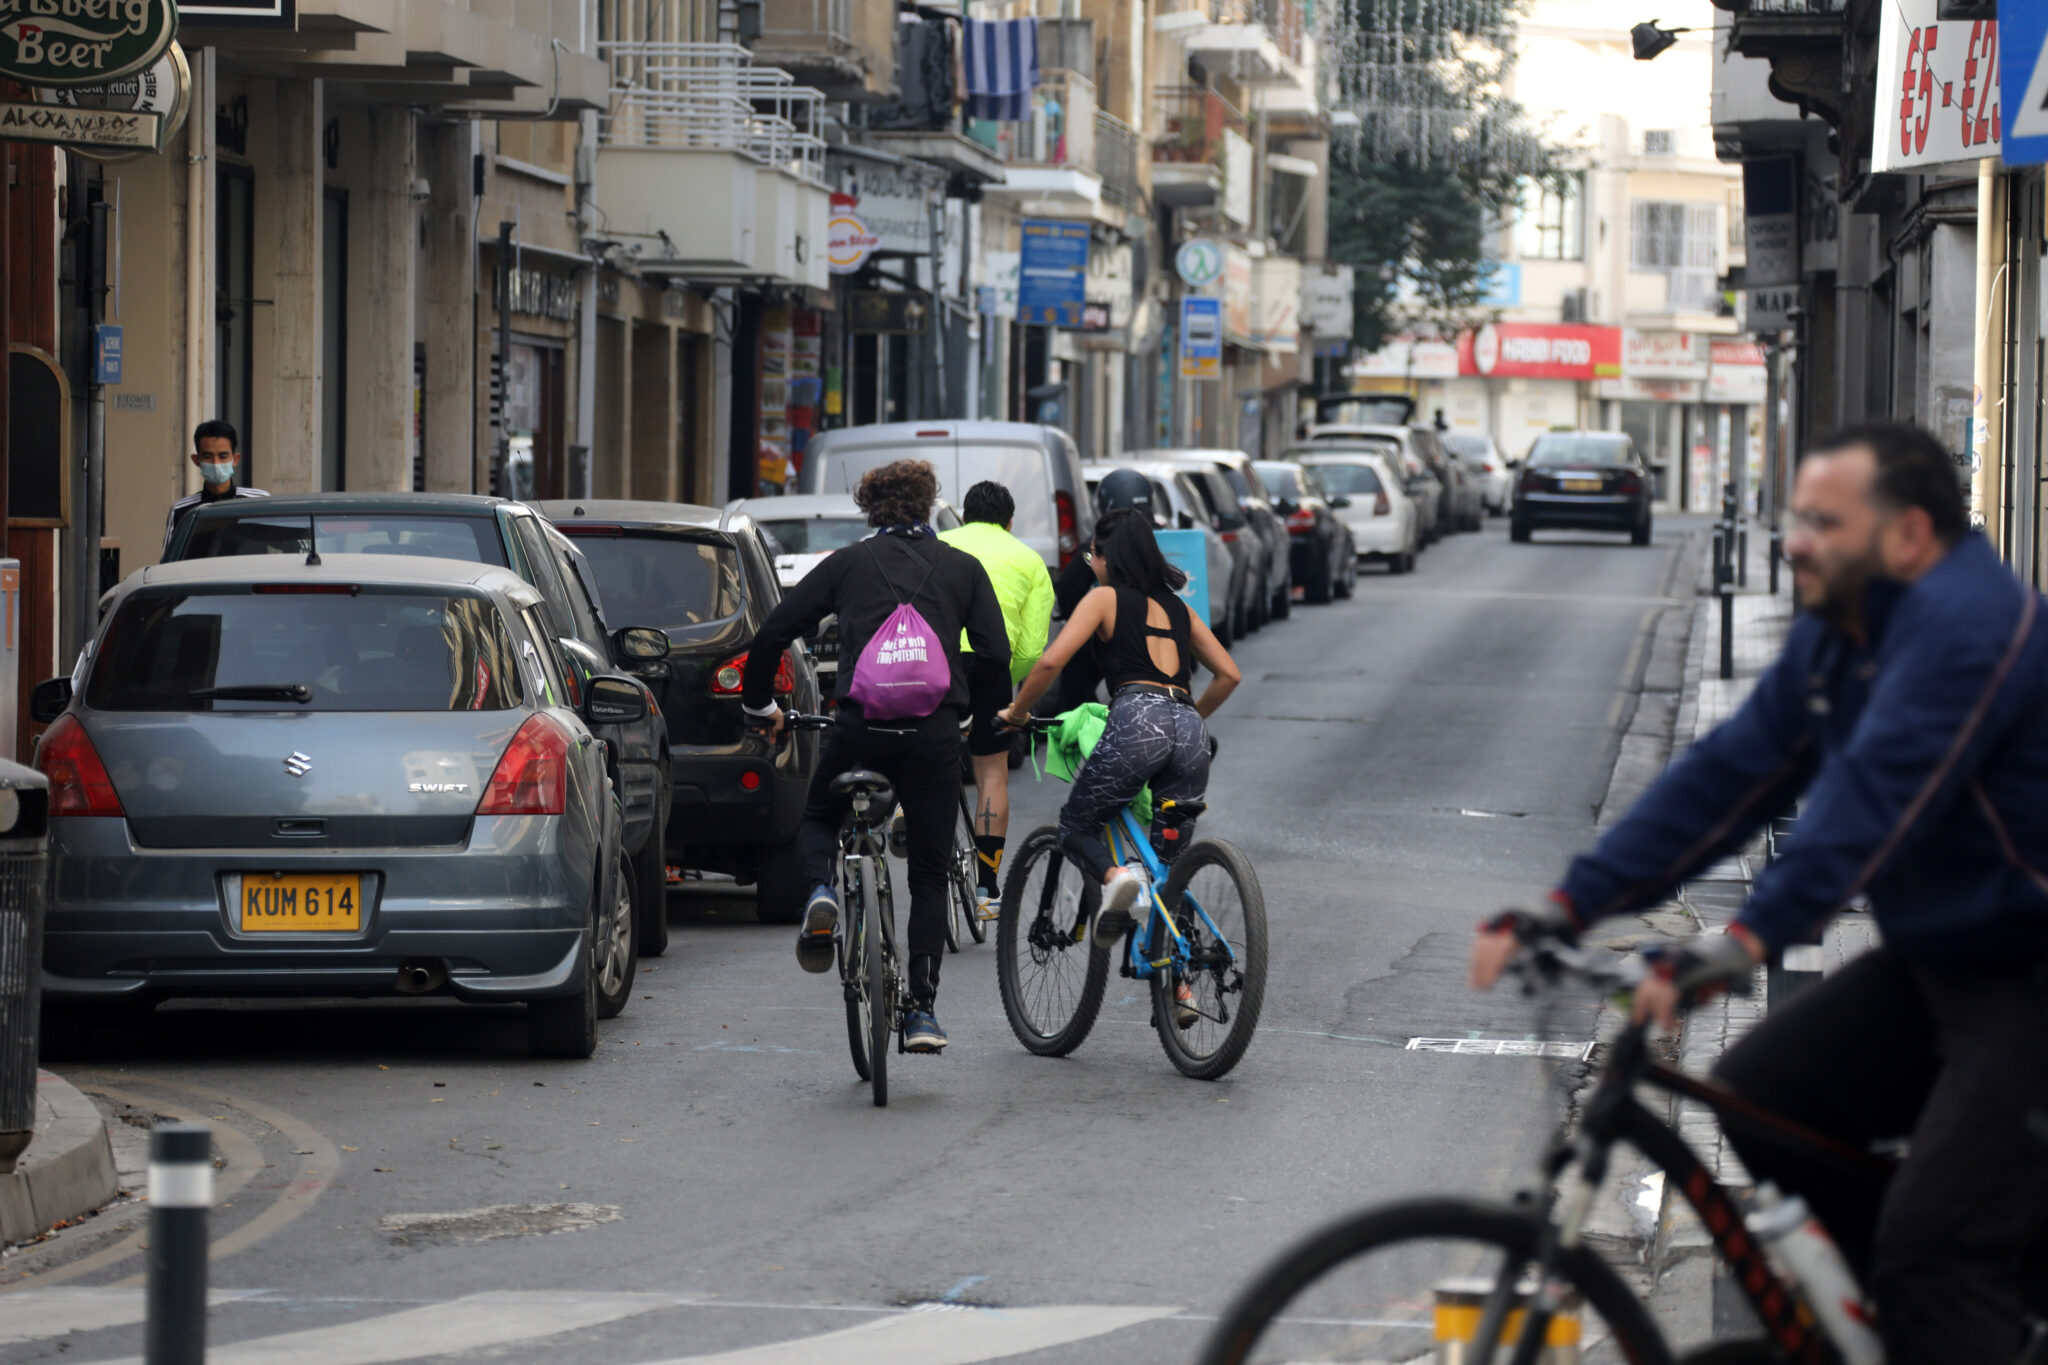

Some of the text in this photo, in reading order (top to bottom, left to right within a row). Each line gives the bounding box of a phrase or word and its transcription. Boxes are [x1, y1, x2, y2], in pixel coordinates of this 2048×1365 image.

[16, 24, 113, 68] Beer
[1900, 26, 1938, 156] €5
[1942, 81, 1953, 108] -
[1751, 222, 1791, 234] OPTICAL
[1755, 239, 1788, 250] HOUSE
[1501, 337, 1591, 365] HABIBI FOOD
[899, 637, 907, 649] UP
[893, 648, 928, 662] POTENTIAL
[408, 783, 469, 793] SWIFT
[247, 887, 354, 916] KUM 614
